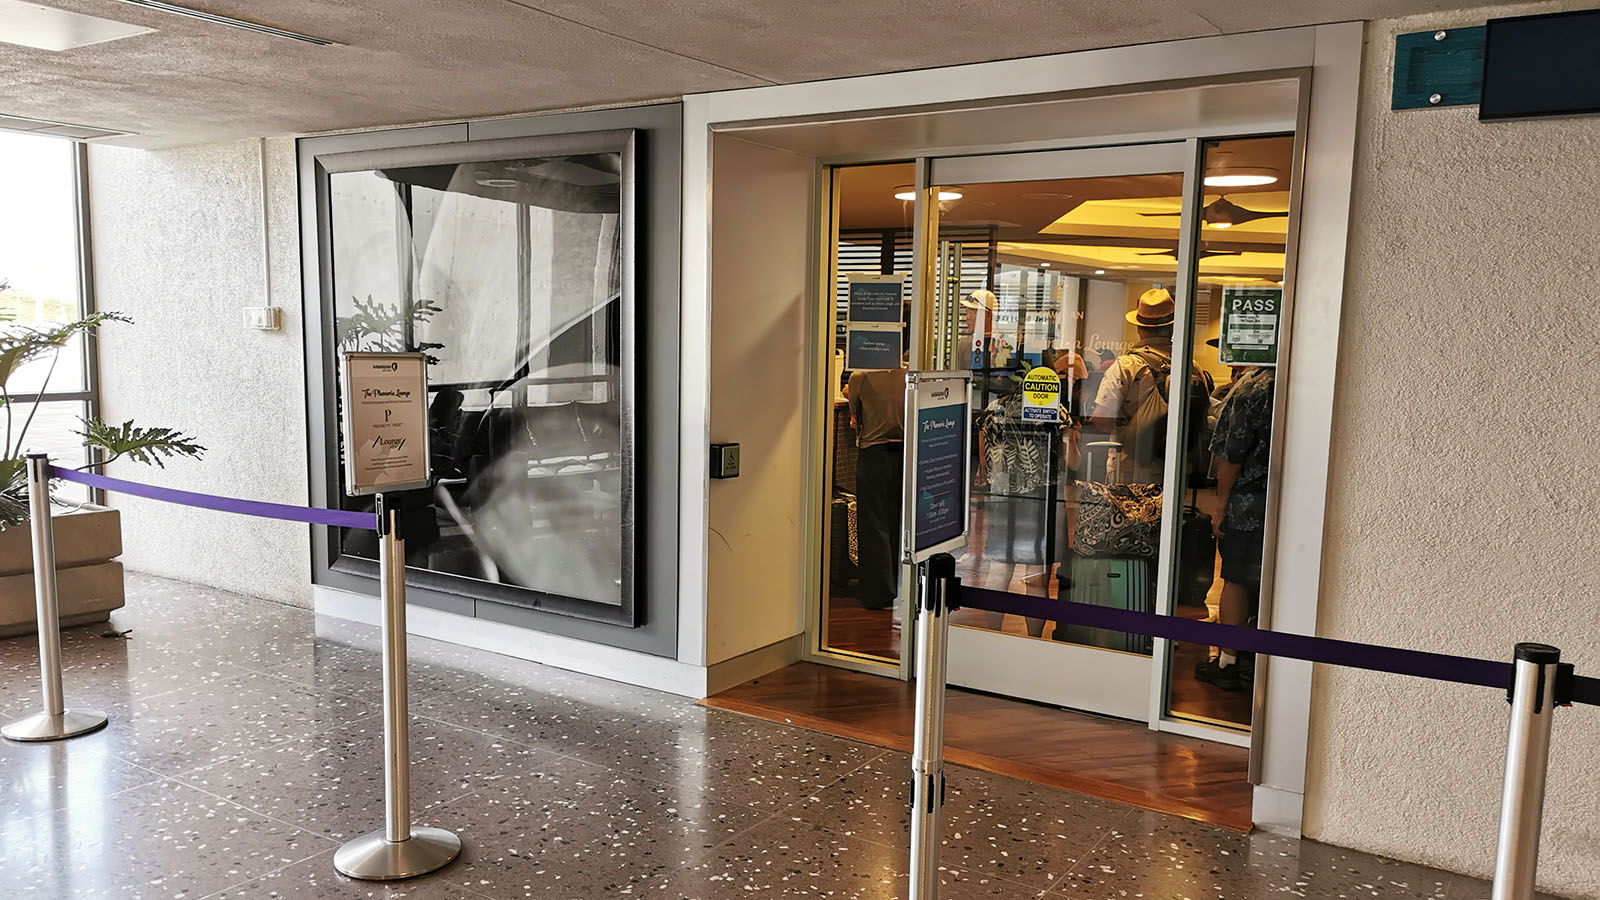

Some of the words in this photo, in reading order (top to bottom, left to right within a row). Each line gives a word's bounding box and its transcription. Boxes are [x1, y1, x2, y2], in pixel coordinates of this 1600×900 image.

[1232, 299, 1275, 311] PASS
[1025, 382, 1058, 391] CAUTION
[361, 388, 372, 399] The
